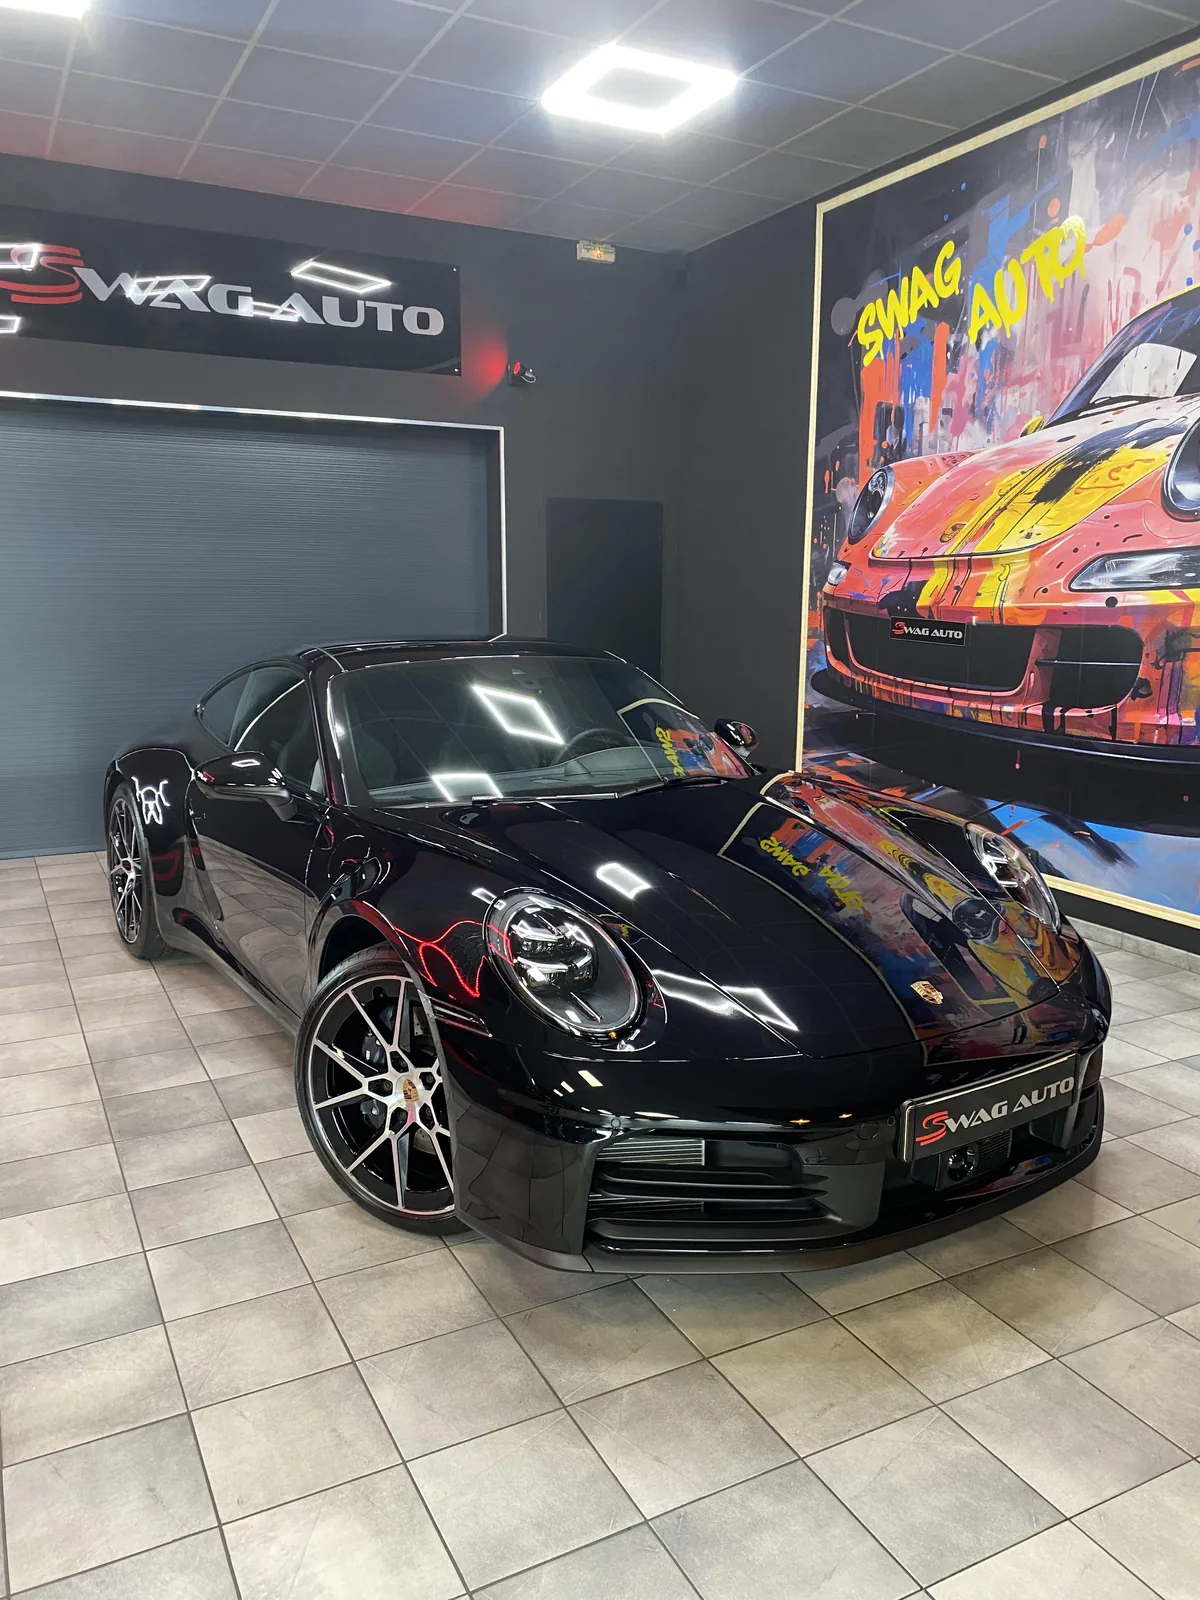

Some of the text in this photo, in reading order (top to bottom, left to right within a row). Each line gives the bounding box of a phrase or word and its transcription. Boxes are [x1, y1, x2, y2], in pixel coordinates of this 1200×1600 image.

[0, 243, 445, 336] SWAG AUTO
[857, 215, 1087, 367] SWAG AUTO
[892, 621, 963, 639] SWAG AUTO
[915, 1076, 1075, 1146] SWAG AUTO
